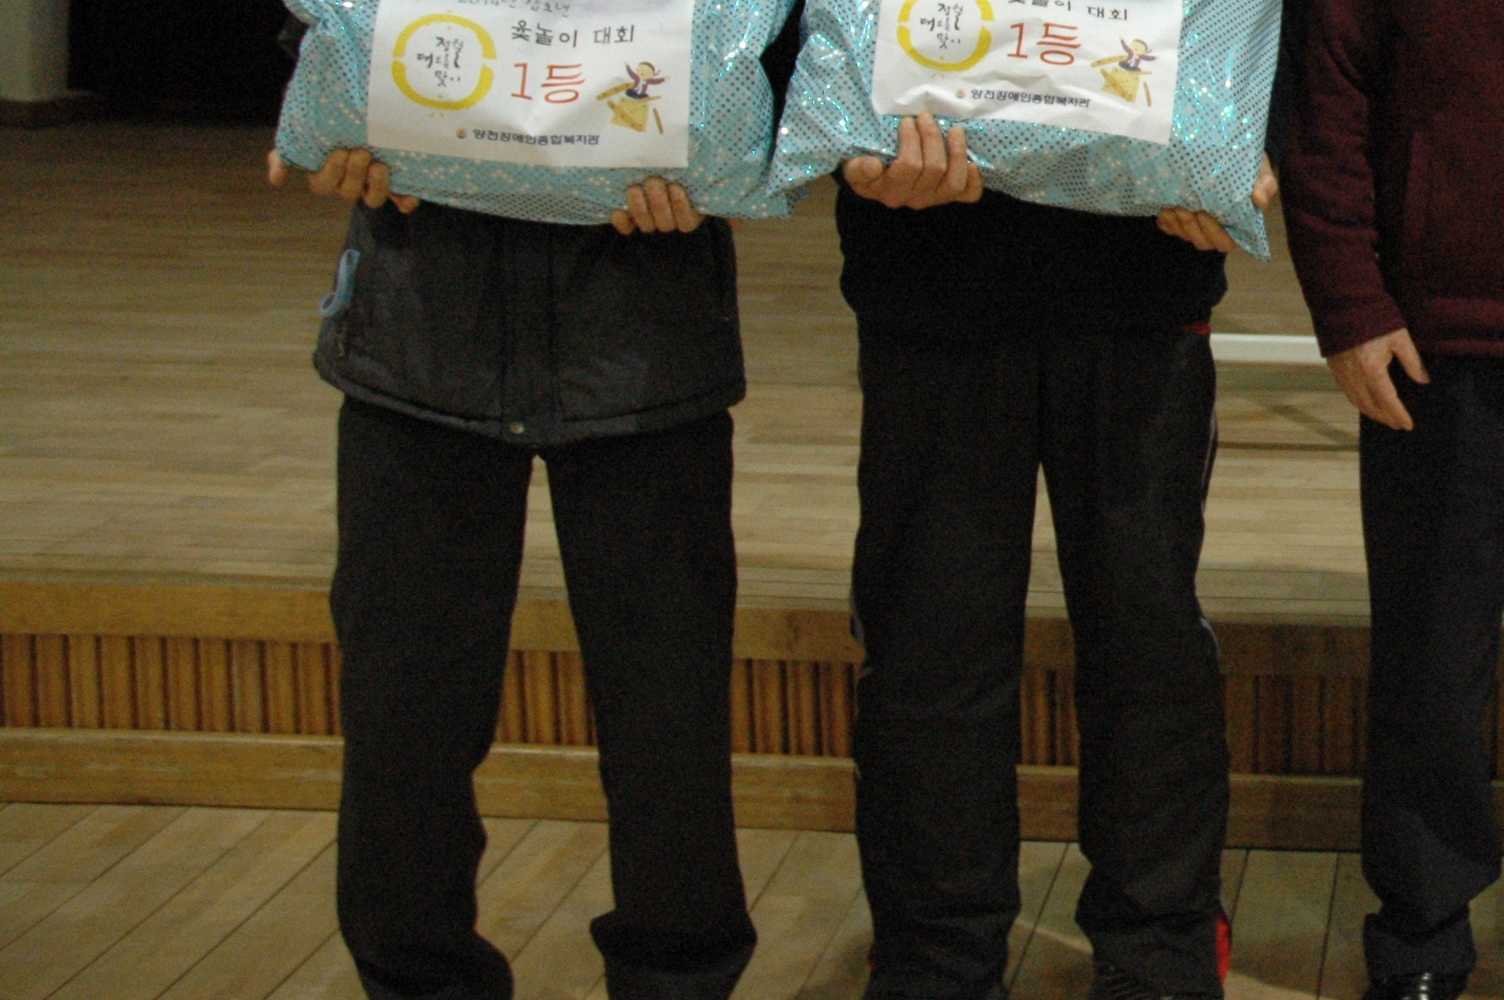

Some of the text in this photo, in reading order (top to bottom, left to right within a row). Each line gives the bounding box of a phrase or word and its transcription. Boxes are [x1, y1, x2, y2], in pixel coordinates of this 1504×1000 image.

[1087, 5, 1128, 21] 대회
[511, 19, 635, 48] 윷놀이 대회
[1007, 22, 1082, 66] 1등
[510, 62, 586, 104] 1등
